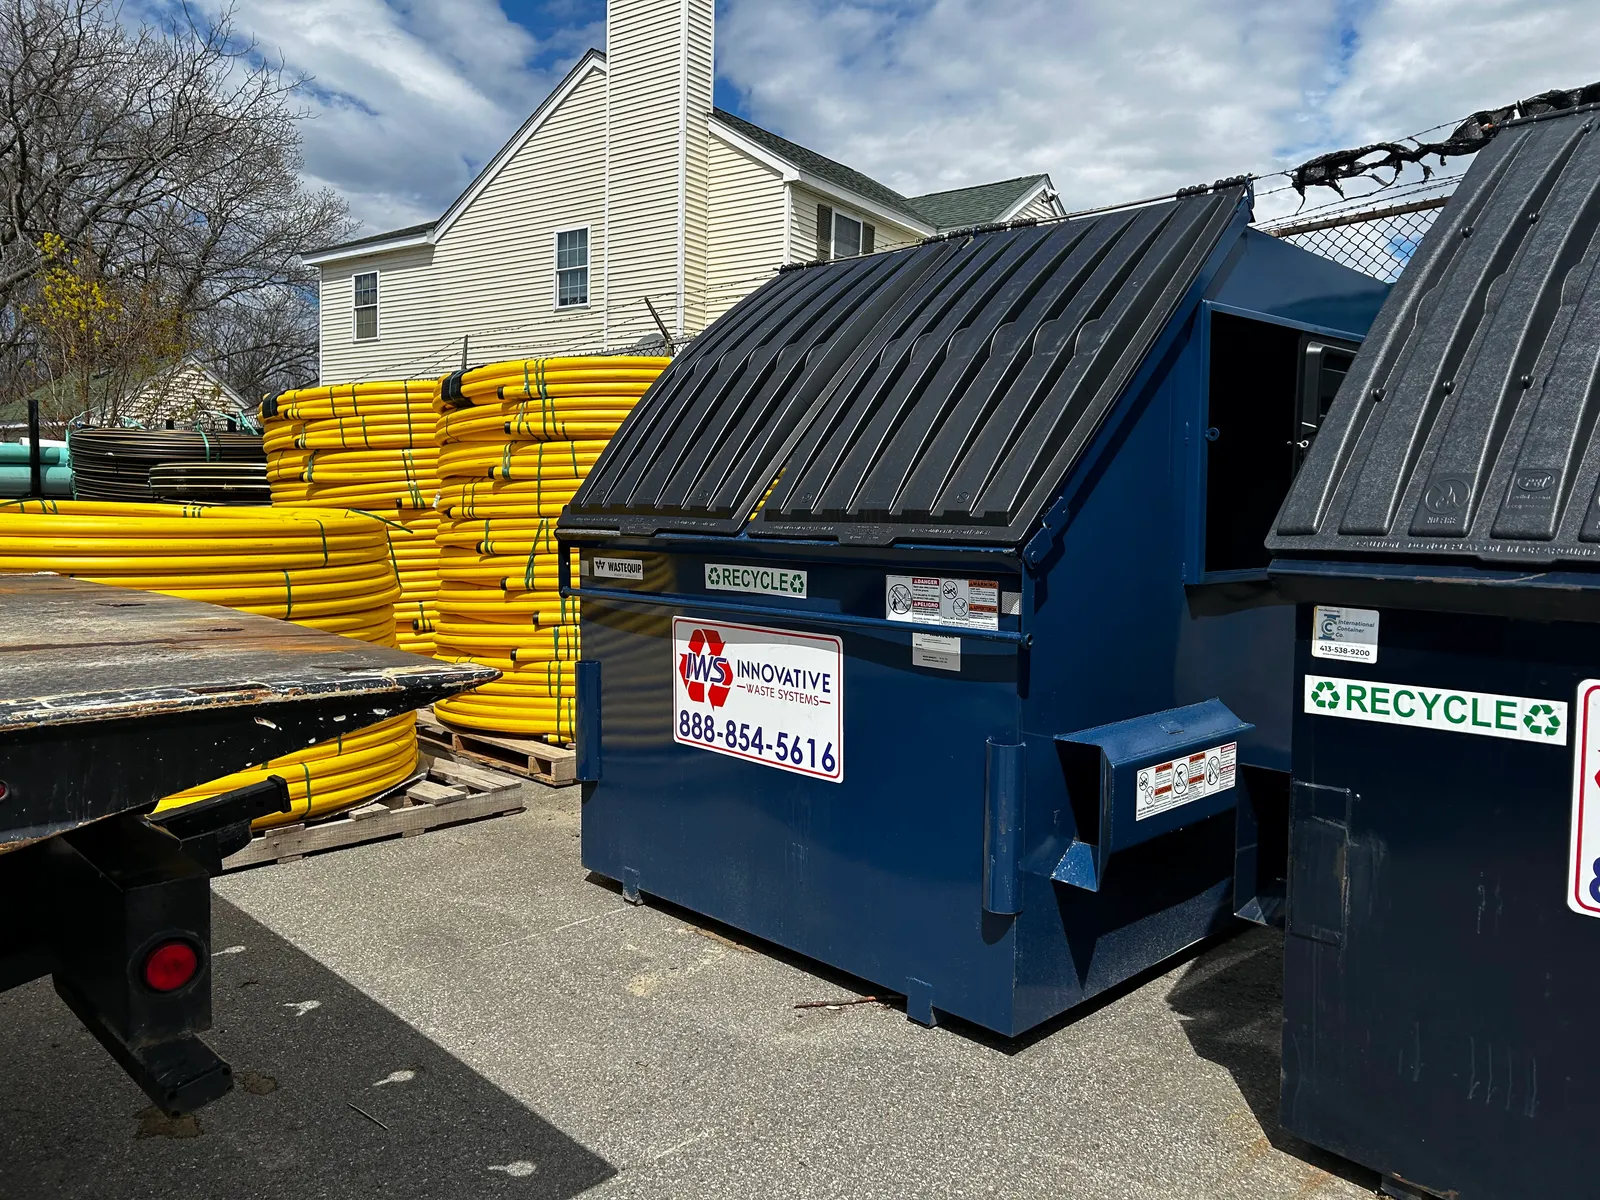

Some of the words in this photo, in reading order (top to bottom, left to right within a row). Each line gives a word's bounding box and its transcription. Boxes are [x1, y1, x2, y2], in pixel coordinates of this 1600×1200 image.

[607, 561, 642, 574] WASTEQUIP
[722, 567, 789, 592] RECYCLE
[1338, 620, 1375, 628] International
[1320, 645, 1371, 656] 413-538-9200
[686, 652, 728, 684] IWS
[737, 659, 831, 694] INNOVATIVE
[746, 683, 775, 699] WASTE
[777, 688, 820, 706] SYSTEMS
[1346, 684, 1518, 732] RECYCLE
[679, 709, 836, 772] 888-854-5616
